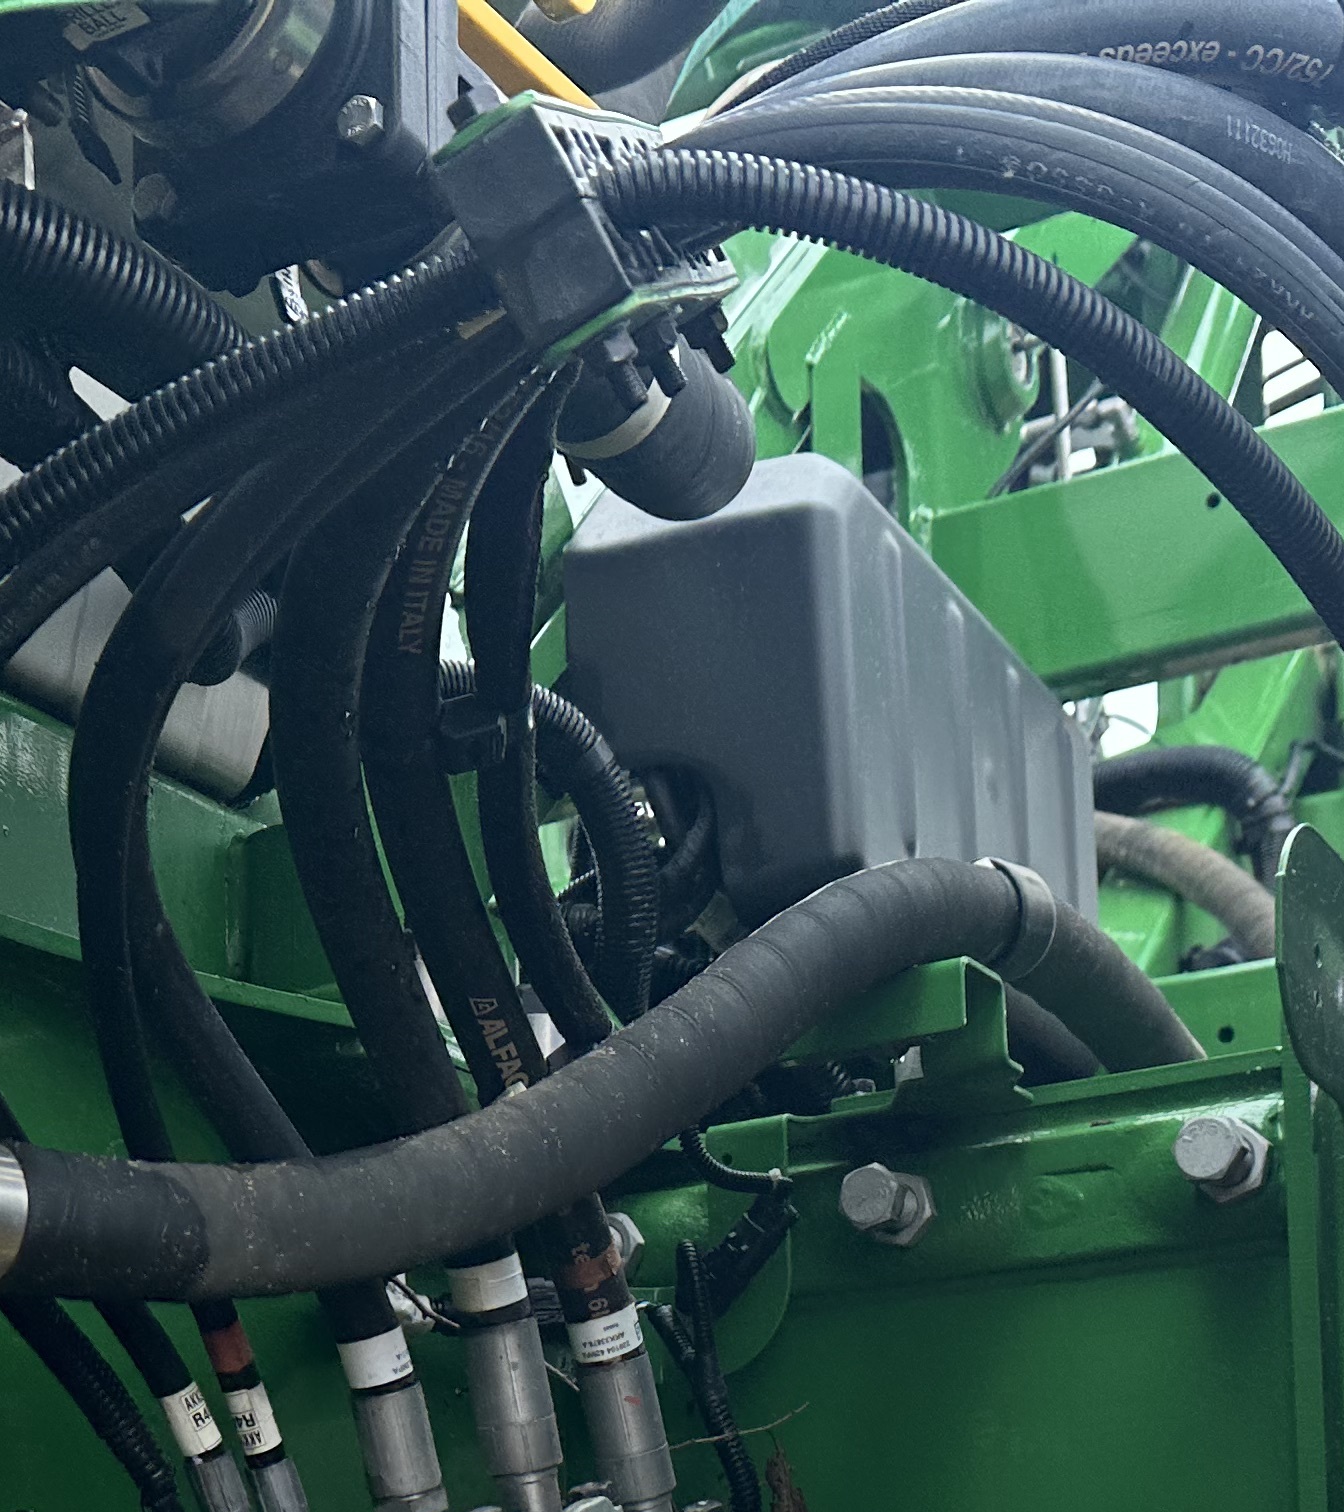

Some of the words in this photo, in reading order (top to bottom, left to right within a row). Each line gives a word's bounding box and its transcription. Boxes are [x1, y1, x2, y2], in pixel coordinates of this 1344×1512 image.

[418, 476, 467, 553] MADE
[408, 560, 438, 584] IN
[398, 590, 430, 655] ITALY
